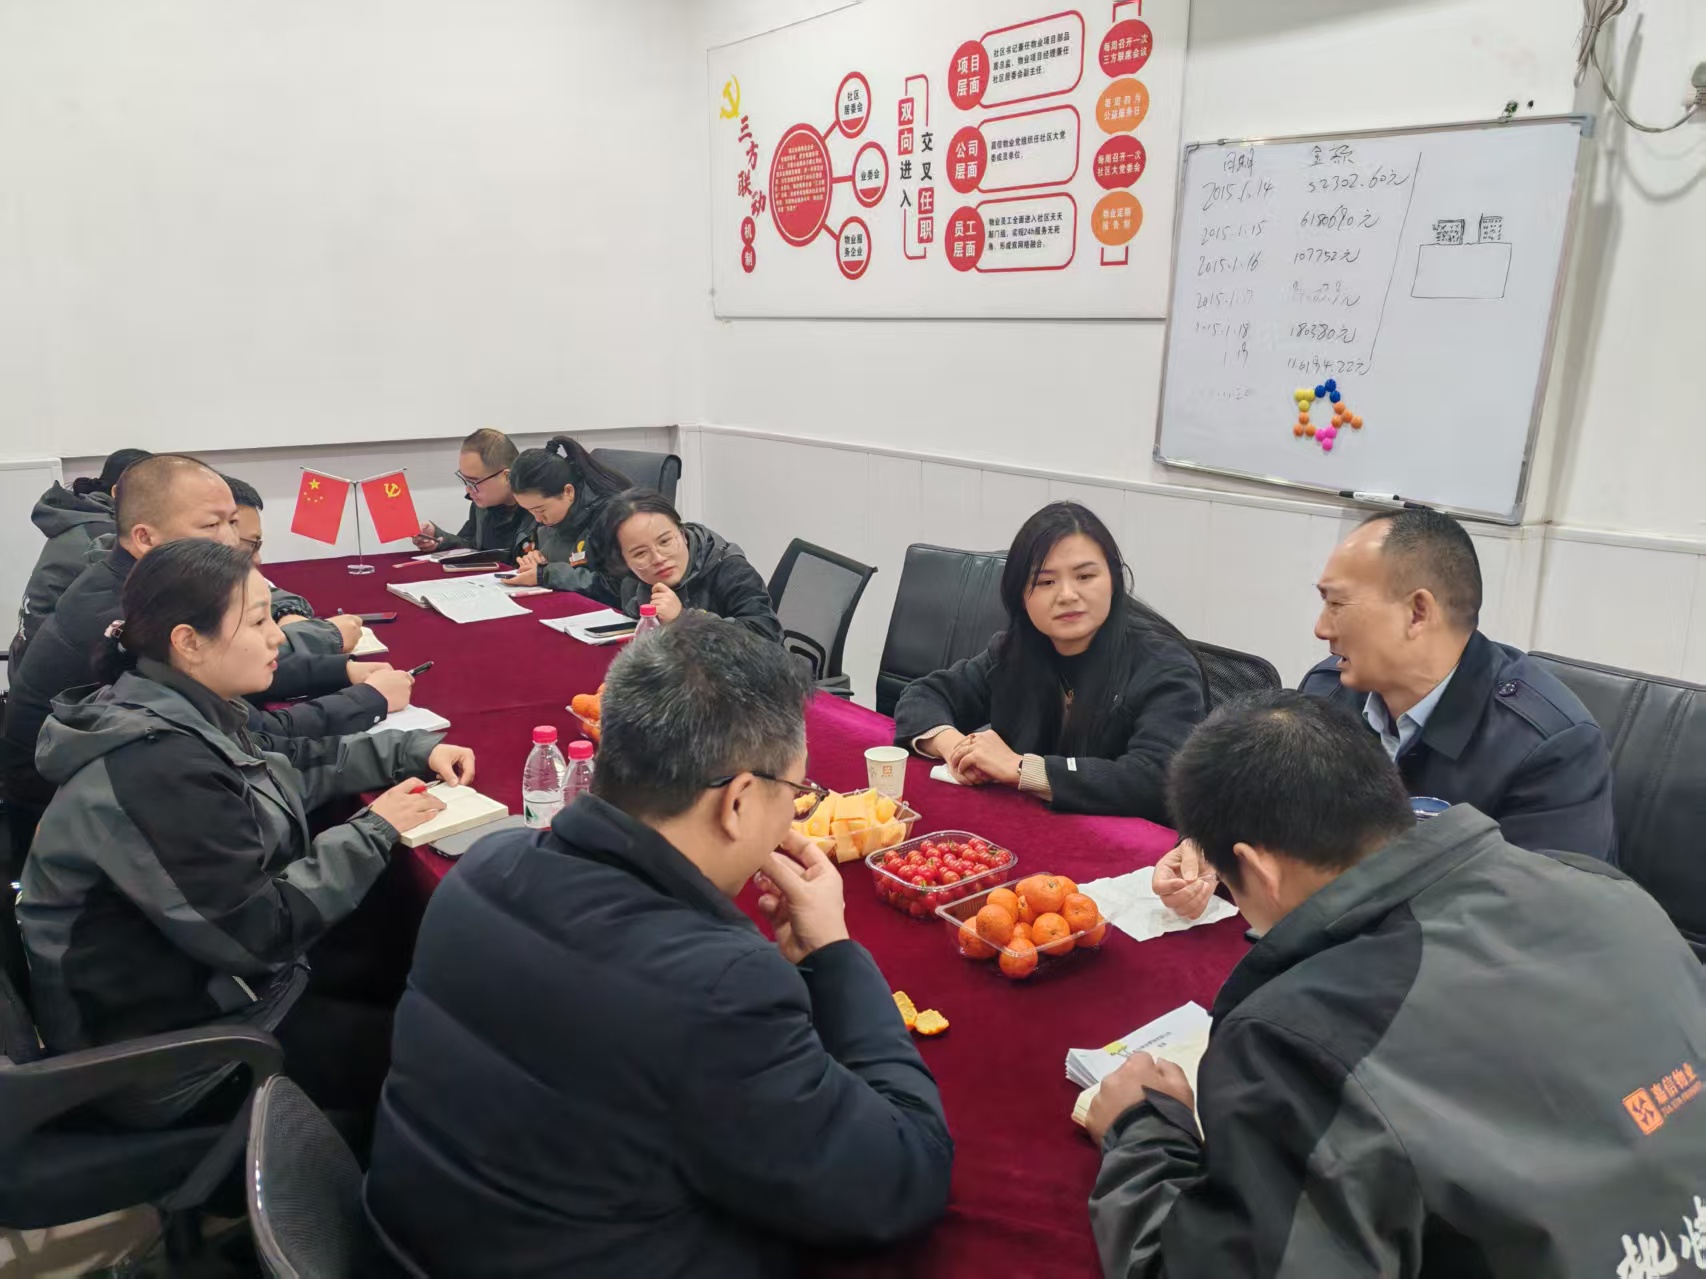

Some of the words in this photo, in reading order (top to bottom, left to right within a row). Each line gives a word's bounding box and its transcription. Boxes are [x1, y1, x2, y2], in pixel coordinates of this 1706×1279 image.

[957, 54, 979, 75] 项目
[1103, 46, 1148, 65] 三方联席会议
[847, 89, 860, 101] 社区
[957, 78, 979, 97] 层面
[898, 101, 914, 209] 双向进入
[955, 139, 978, 159] 公司
[737, 115, 767, 218] 三方联动
[861, 168, 880, 181] 业委会
[955, 162, 977, 180] 层面
[1097, 162, 1141, 177] 社区大党委会
[919, 131, 934, 239] 交叉任职
[954, 219, 976, 238] 员工
[844, 233, 863, 246] 物业服
[844, 246, 863, 258] 务企业
[953, 241, 976, 258] 层面
